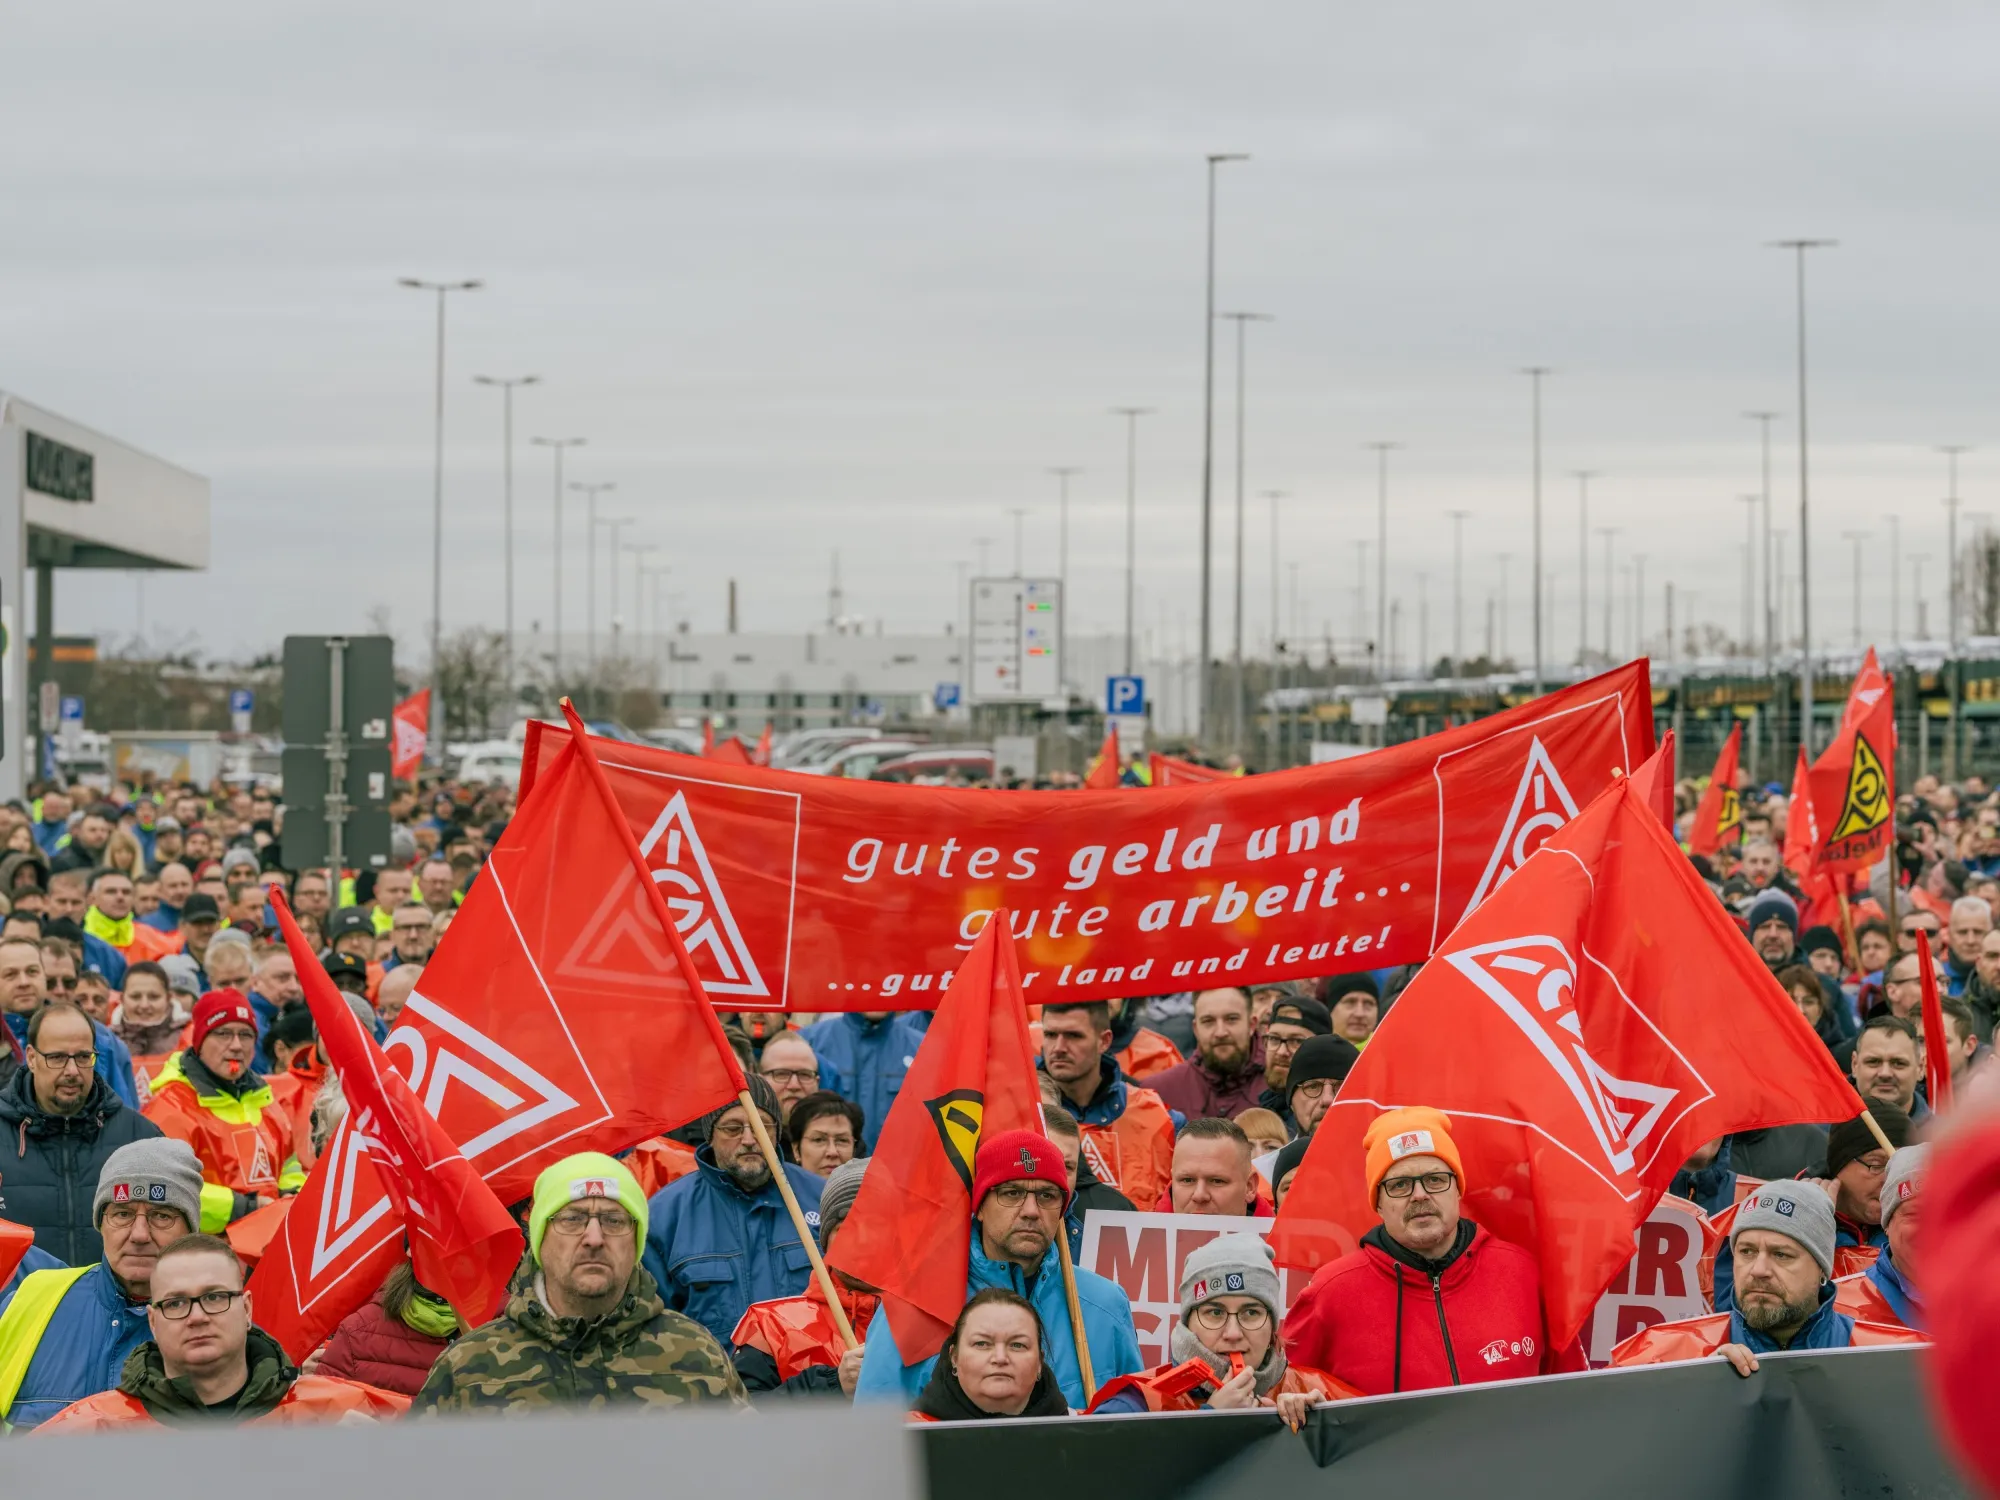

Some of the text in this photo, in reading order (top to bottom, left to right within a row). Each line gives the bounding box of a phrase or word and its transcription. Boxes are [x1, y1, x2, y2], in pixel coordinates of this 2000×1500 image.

[1113, 680, 1138, 711] P
[843, 797, 1363, 890] gutes geld und
[954, 866, 1411, 951] gute arbeit...
[1057, 959, 1154, 986] land
[1171, 948, 1249, 977] und
[1265, 925, 1392, 967] leute!
